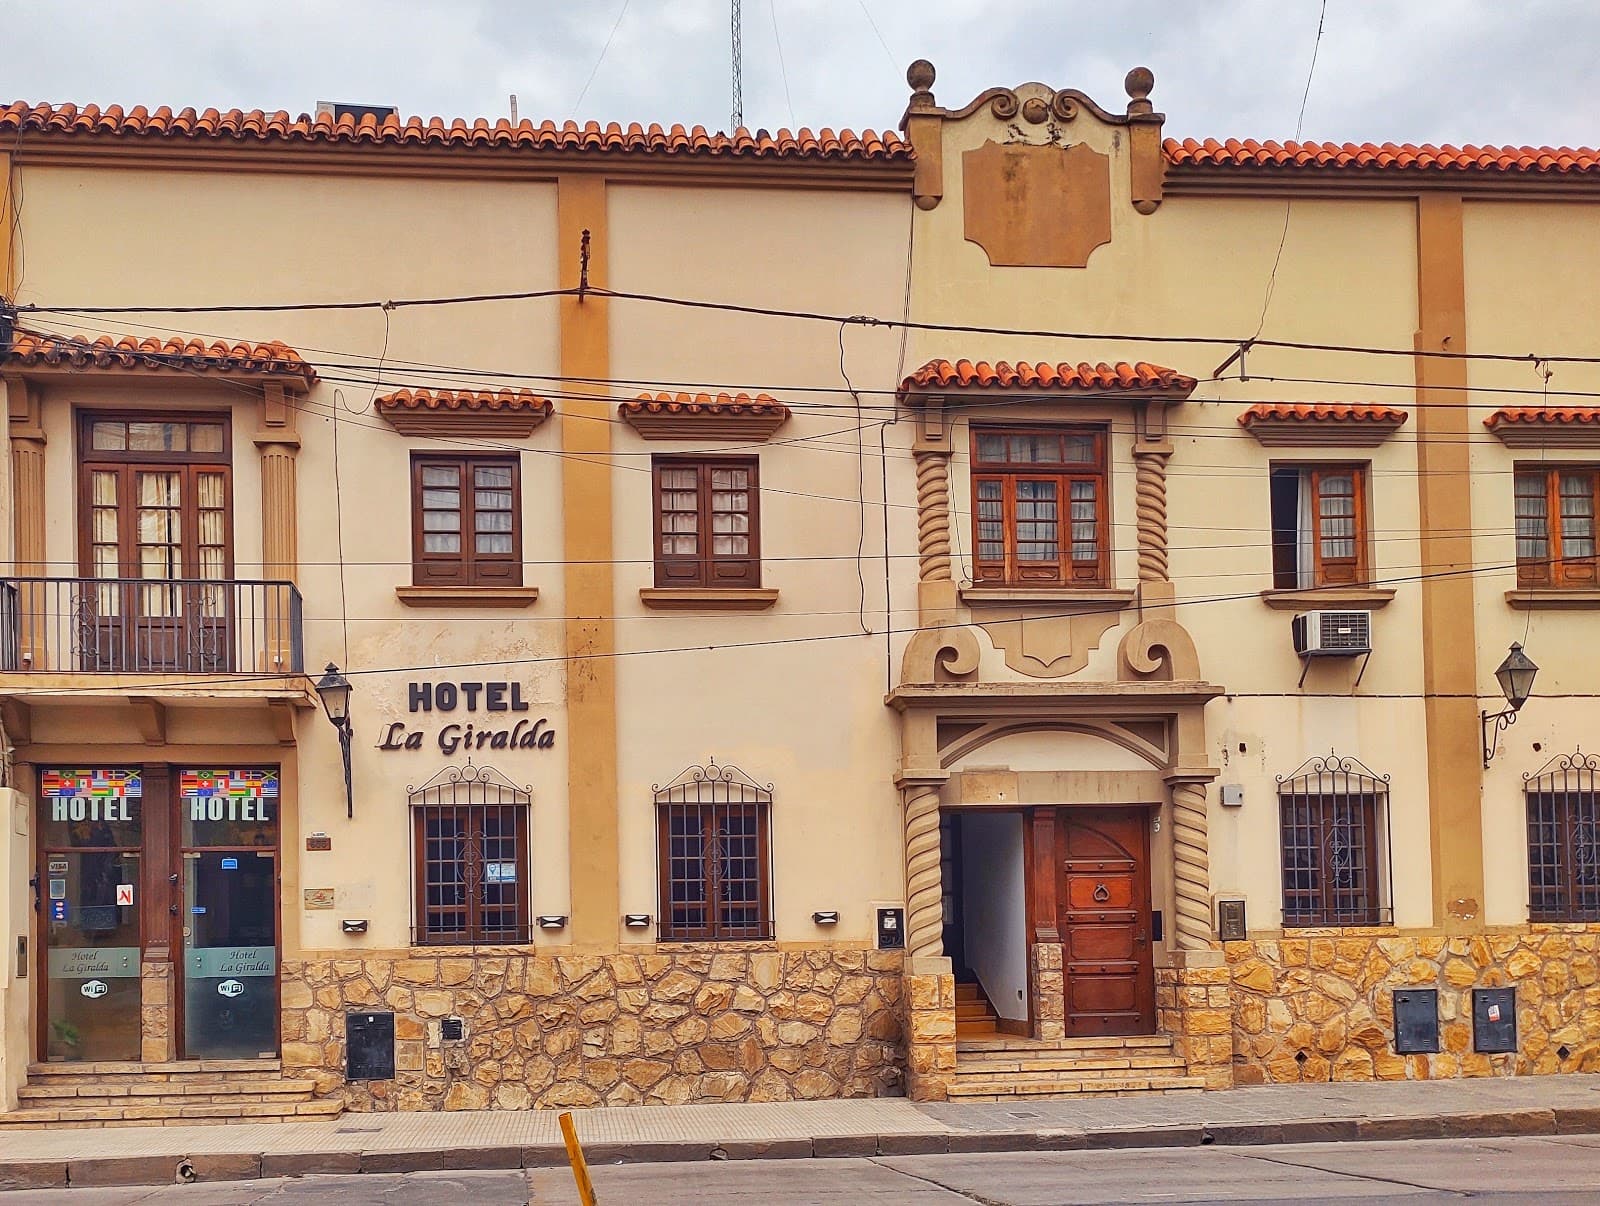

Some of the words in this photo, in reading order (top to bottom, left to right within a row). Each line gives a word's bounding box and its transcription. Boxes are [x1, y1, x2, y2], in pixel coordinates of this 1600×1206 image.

[408, 682, 529, 712] HOTEL
[380, 722, 424, 750] La
[438, 719, 555, 755] Giralda
[52, 797, 132, 821] HOTEL
[190, 797, 269, 821] HOTEL
[71, 951, 99, 961] Hotel
[229, 949, 258, 960] Hotel
[63, 964, 74, 972] La
[76, 962, 109, 974] Giralda
[219, 963, 233, 972] La
[235, 961, 270, 974] Giralda
